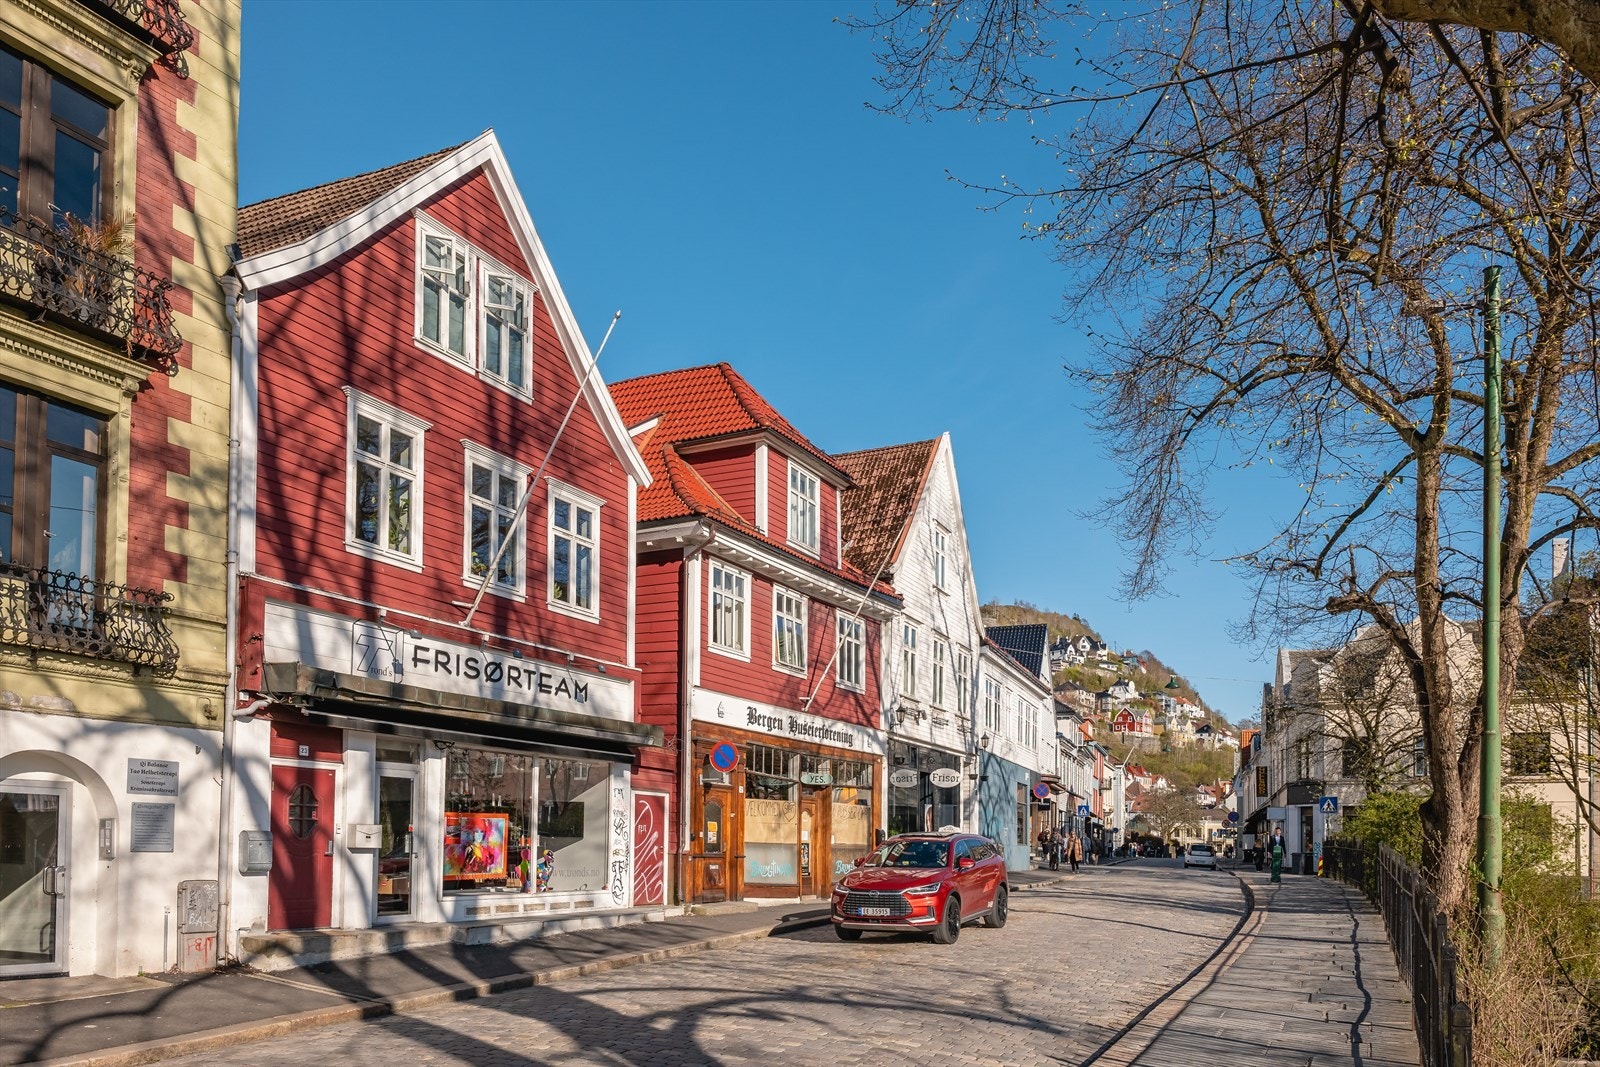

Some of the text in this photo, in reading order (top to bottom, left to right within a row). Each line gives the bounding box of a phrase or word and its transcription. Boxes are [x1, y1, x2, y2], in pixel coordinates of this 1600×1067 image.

[411, 645, 589, 703] FRISØRTEAM
[746, 706, 784, 732] Bergen
[810, 775, 826, 784] YES.
[932, 773, 960, 783] Frisør
[551, 866, 600, 878] ww.tronds.no
